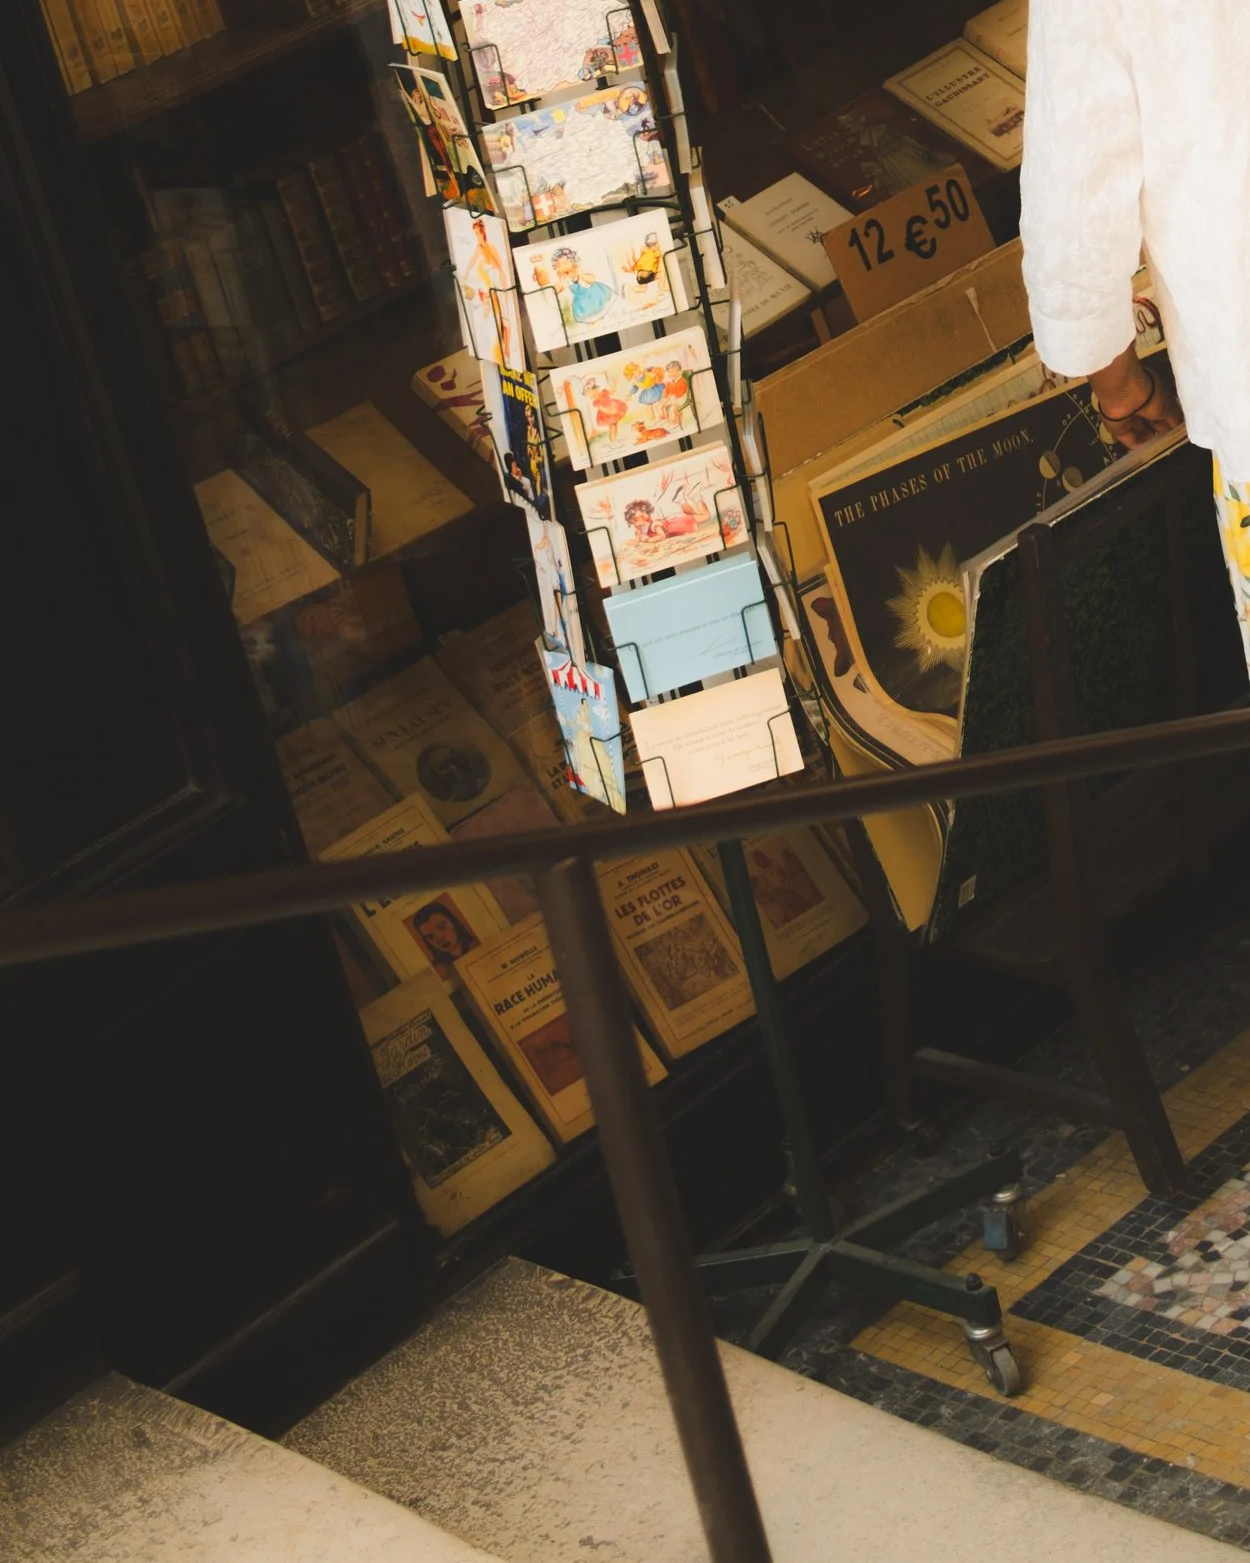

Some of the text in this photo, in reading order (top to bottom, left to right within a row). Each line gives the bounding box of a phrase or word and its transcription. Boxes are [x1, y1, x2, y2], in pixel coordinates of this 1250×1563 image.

[925, 65, 983, 103] L'ILLUSTRE
[933, 71, 991, 110] GAUDISSART
[848, 218, 896, 273] 12
[833, 504, 866, 528] THE
[868, 476, 929, 514] PHASES
[933, 464, 952, 485] OF
[956, 448, 988, 474] THE
[614, 894, 637, 919] LES
[640, 875, 687, 905] FLOTTES
[633, 910, 652, 928] DE
[654, 894, 683, 919] L'OR
[493, 969, 561, 1017] RACE HUMA
